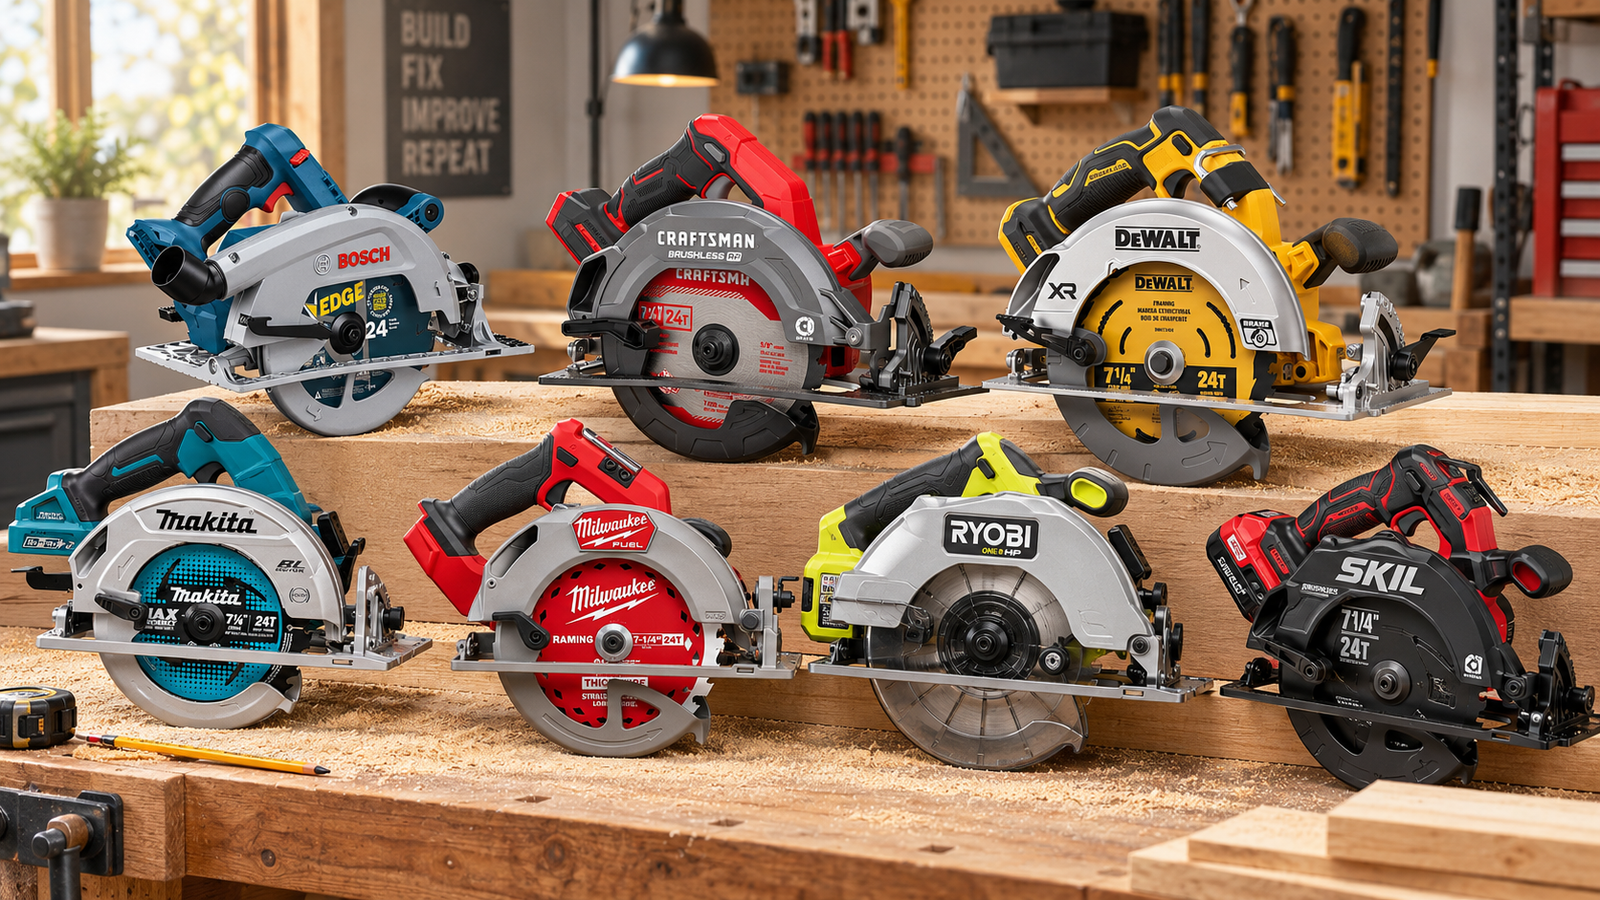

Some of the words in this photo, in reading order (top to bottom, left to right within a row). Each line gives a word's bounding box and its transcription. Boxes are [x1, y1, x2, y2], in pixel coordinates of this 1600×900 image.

[401, 11, 471, 48] BUILD
[401, 54, 443, 90] FIX
[402, 97, 500, 133] IMPROVE
[402, 139, 492, 175] REPEAT
[657, 230, 755, 249] CRAFTSMAN
[338, 246, 391, 269] BOSCH
[668, 250, 725, 260] BRUSHLESS
[319, 281, 365, 317] EDGE
[1048, 282, 1077, 299] XR
[666, 309, 689, 326] 24T
[365, 319, 389, 340] 24
[1197, 370, 1226, 389] 24T
[156, 508, 258, 534] Makita
[573, 513, 648, 539] Milwaukee
[950, 519, 1032, 548] RYOBI
[277, 559, 305, 569] BL
[1004, 549, 1022, 557] HP
[1334, 556, 1425, 596] SKIL
[170, 586, 242, 606] Makita
[565, 577, 656, 614] Milwaukee
[254, 615, 277, 628] 24T
[552, 635, 594, 644] RAMING
[664, 635, 682, 645] 24T
[1340, 635, 1370, 660] 24T
